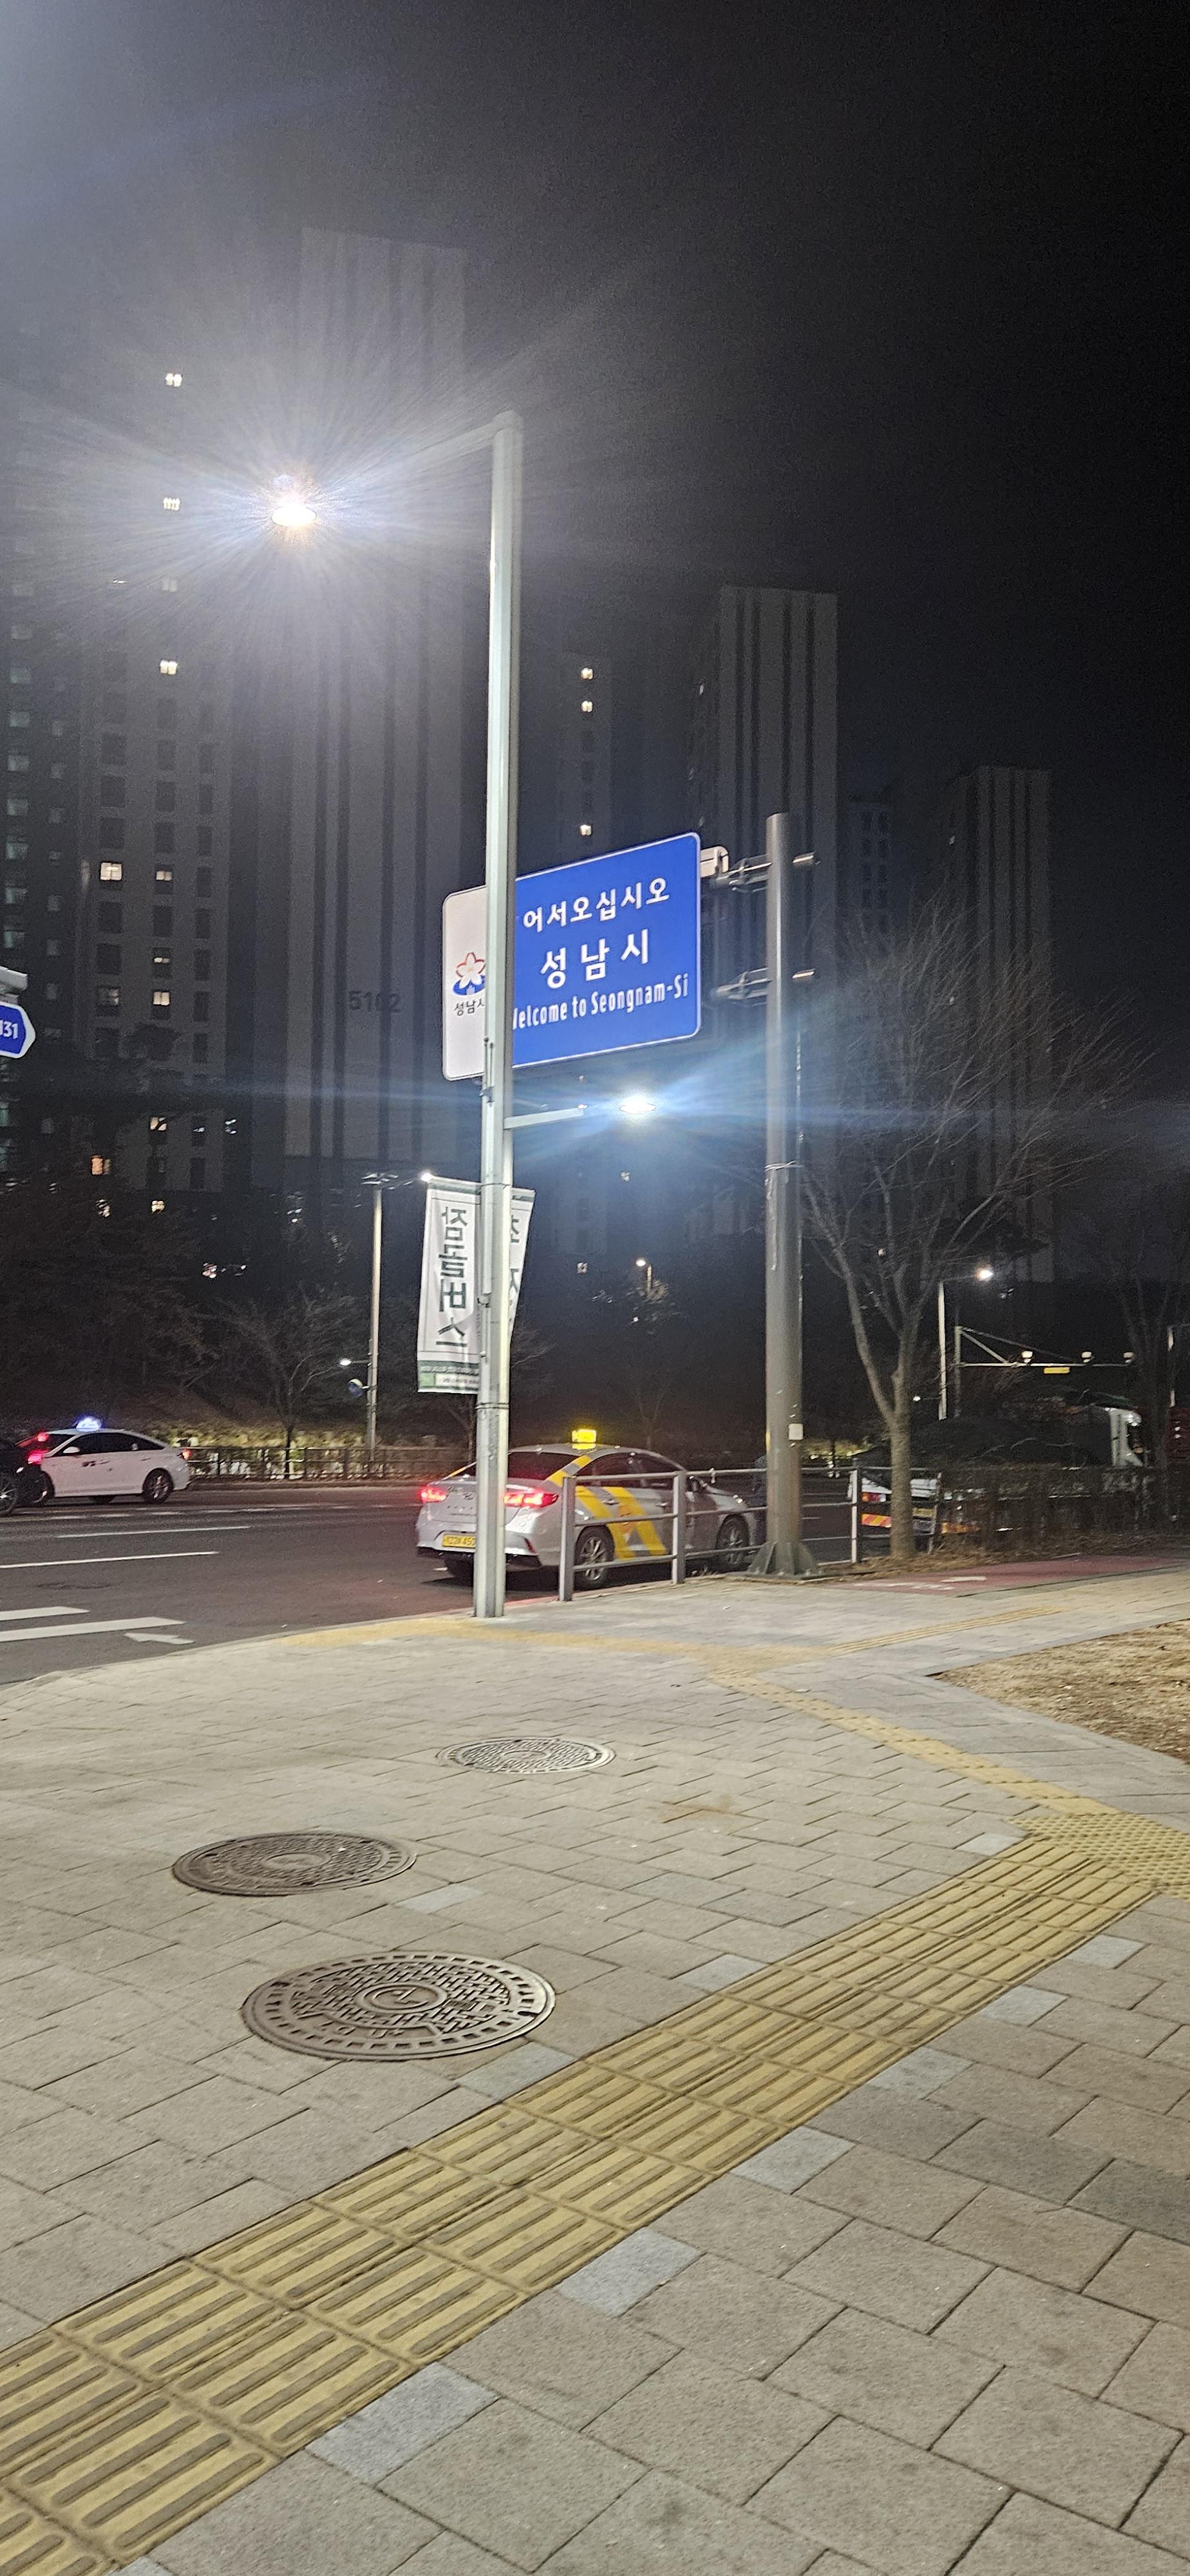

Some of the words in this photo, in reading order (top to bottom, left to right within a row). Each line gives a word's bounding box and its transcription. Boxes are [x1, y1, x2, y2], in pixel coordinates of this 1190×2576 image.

[523, 877, 670, 933] 어서오십시오
[540, 929, 649, 989] 성남시
[513, 1003, 567, 1030] elcome
[572, 996, 587, 1019] to
[590, 972, 689, 1014] Seongnam-Si
